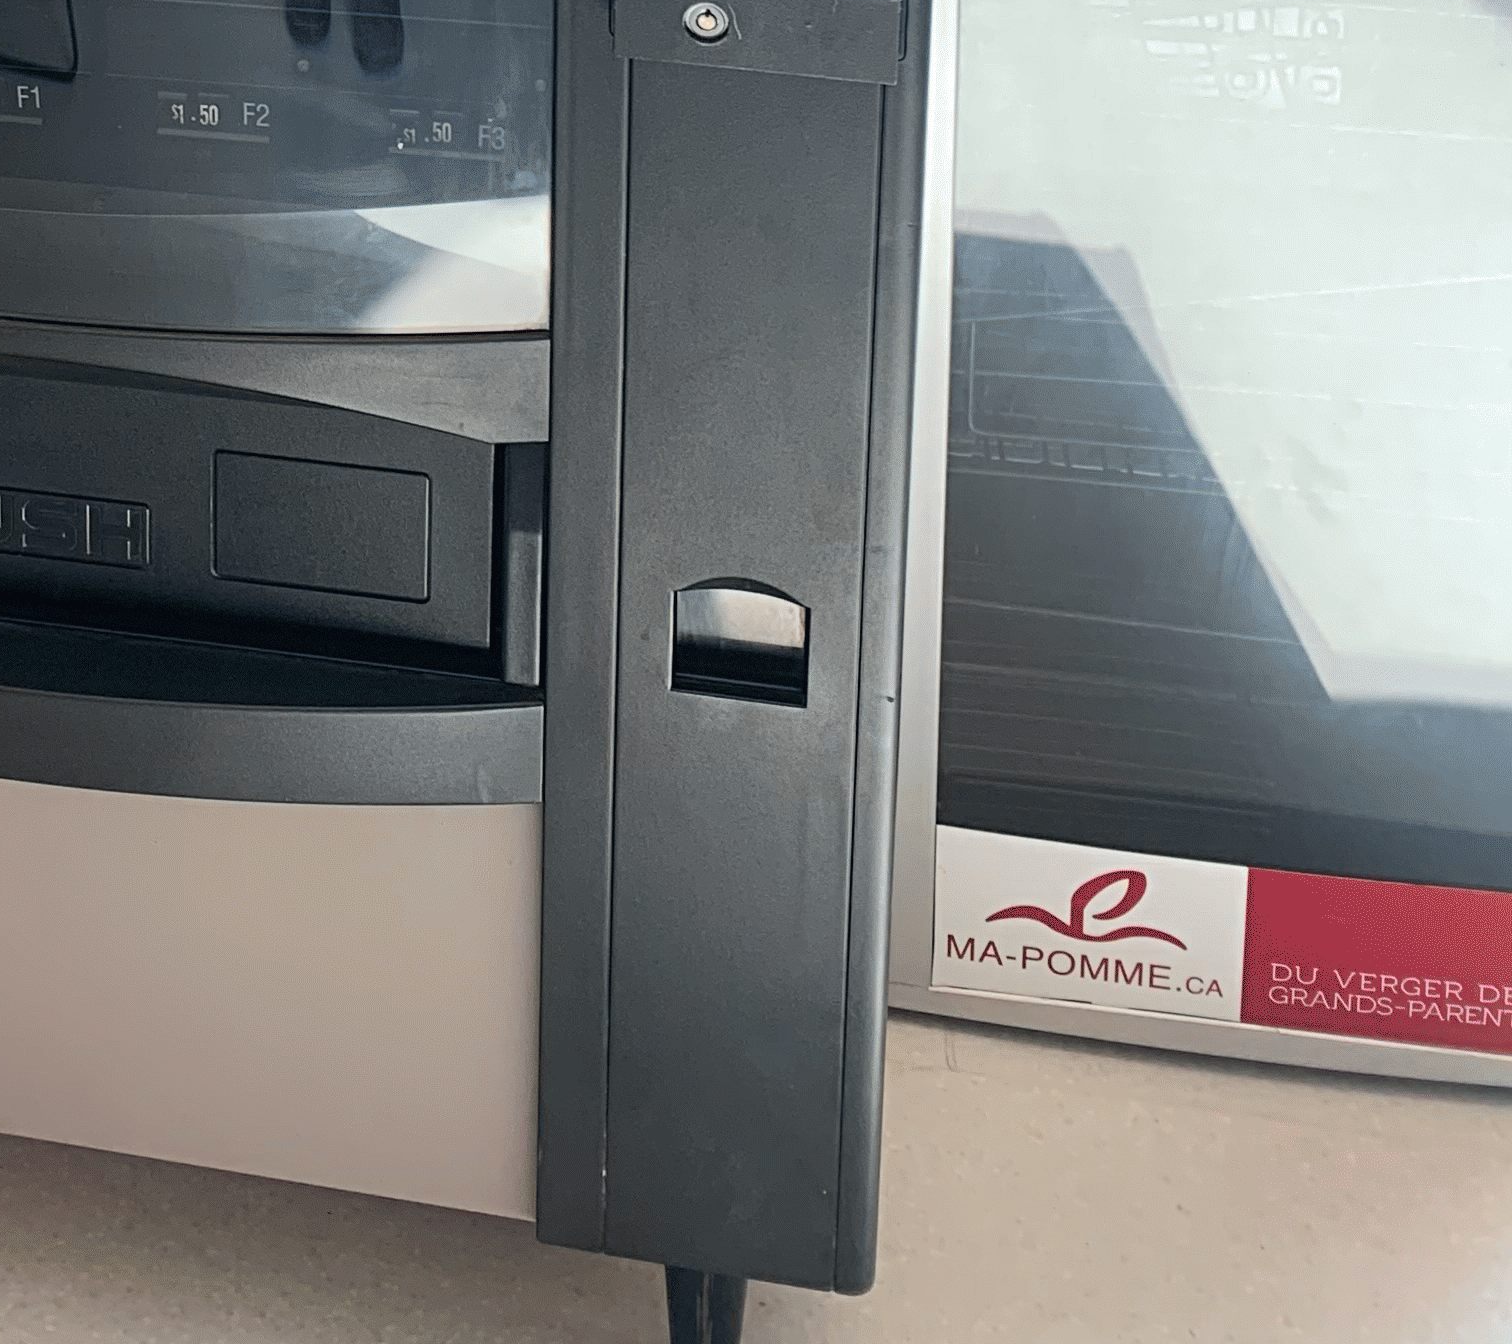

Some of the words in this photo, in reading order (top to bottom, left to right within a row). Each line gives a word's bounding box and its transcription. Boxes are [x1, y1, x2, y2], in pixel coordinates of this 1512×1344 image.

[17, 85, 41, 108] F1
[171, 103, 219, 127] $1.50
[242, 102, 270, 128] F2
[478, 125, 506, 150] F3
[946, 933, 1224, 999] MA-POMME.CA
[1271, 962, 1318, 987] DU
[1334, 969, 1463, 1002] VERGER
